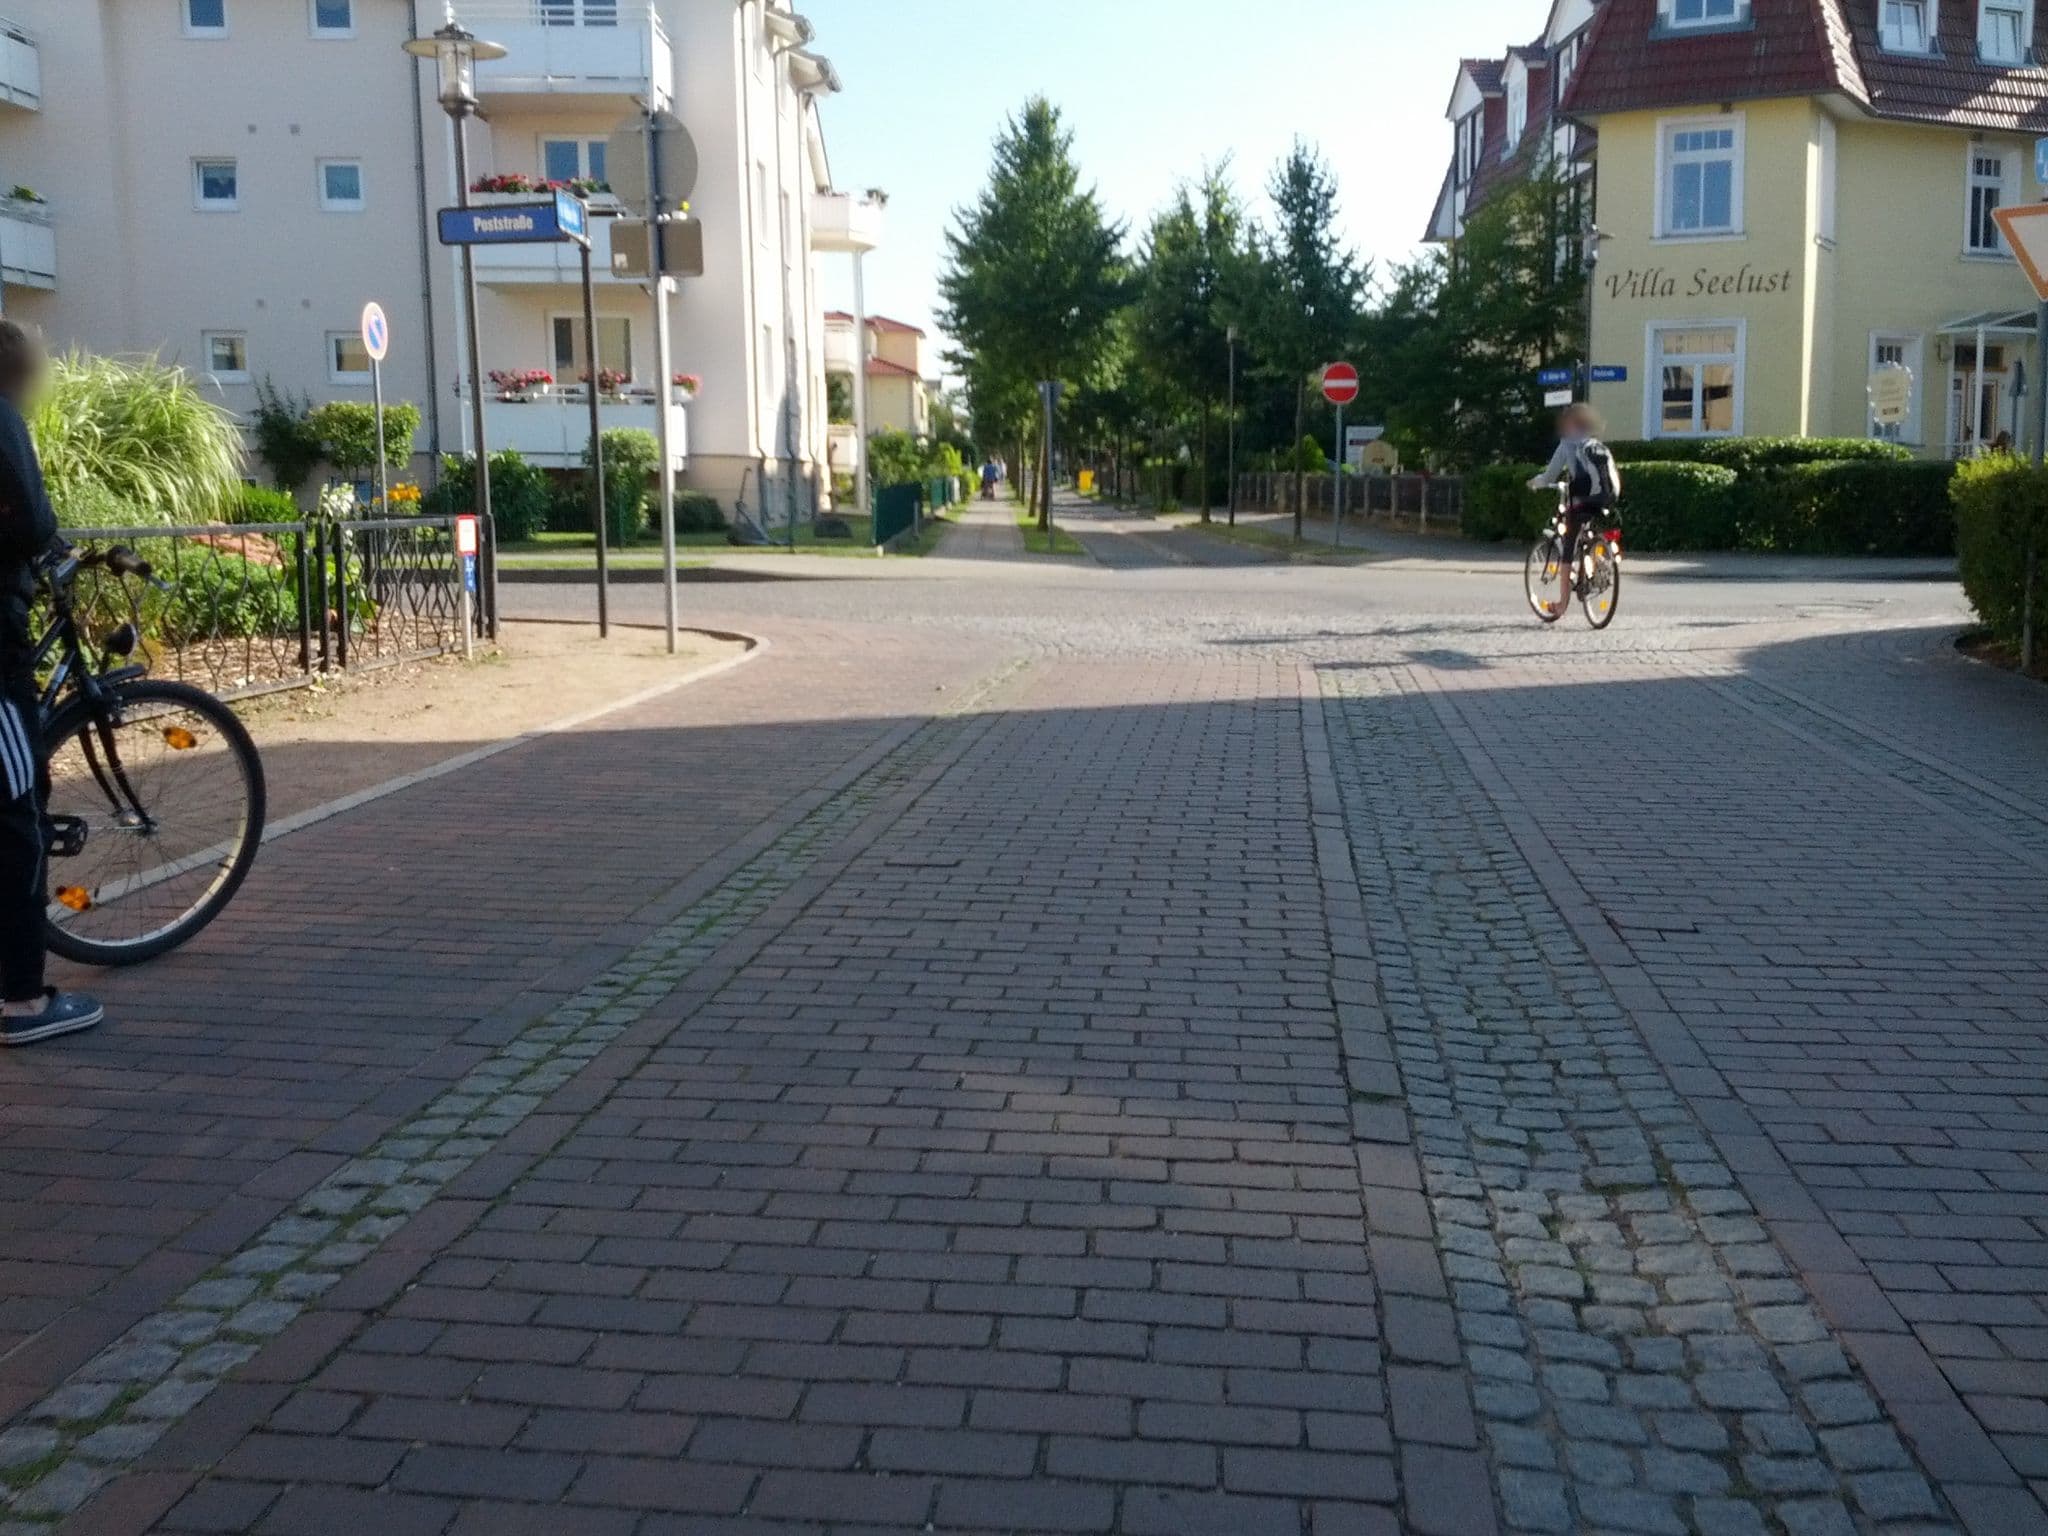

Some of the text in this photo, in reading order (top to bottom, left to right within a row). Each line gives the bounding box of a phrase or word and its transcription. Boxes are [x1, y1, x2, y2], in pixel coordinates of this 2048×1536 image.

[473, 214, 534, 233] Poststraße
[1605, 263, 1791, 299] Villa Seelust
